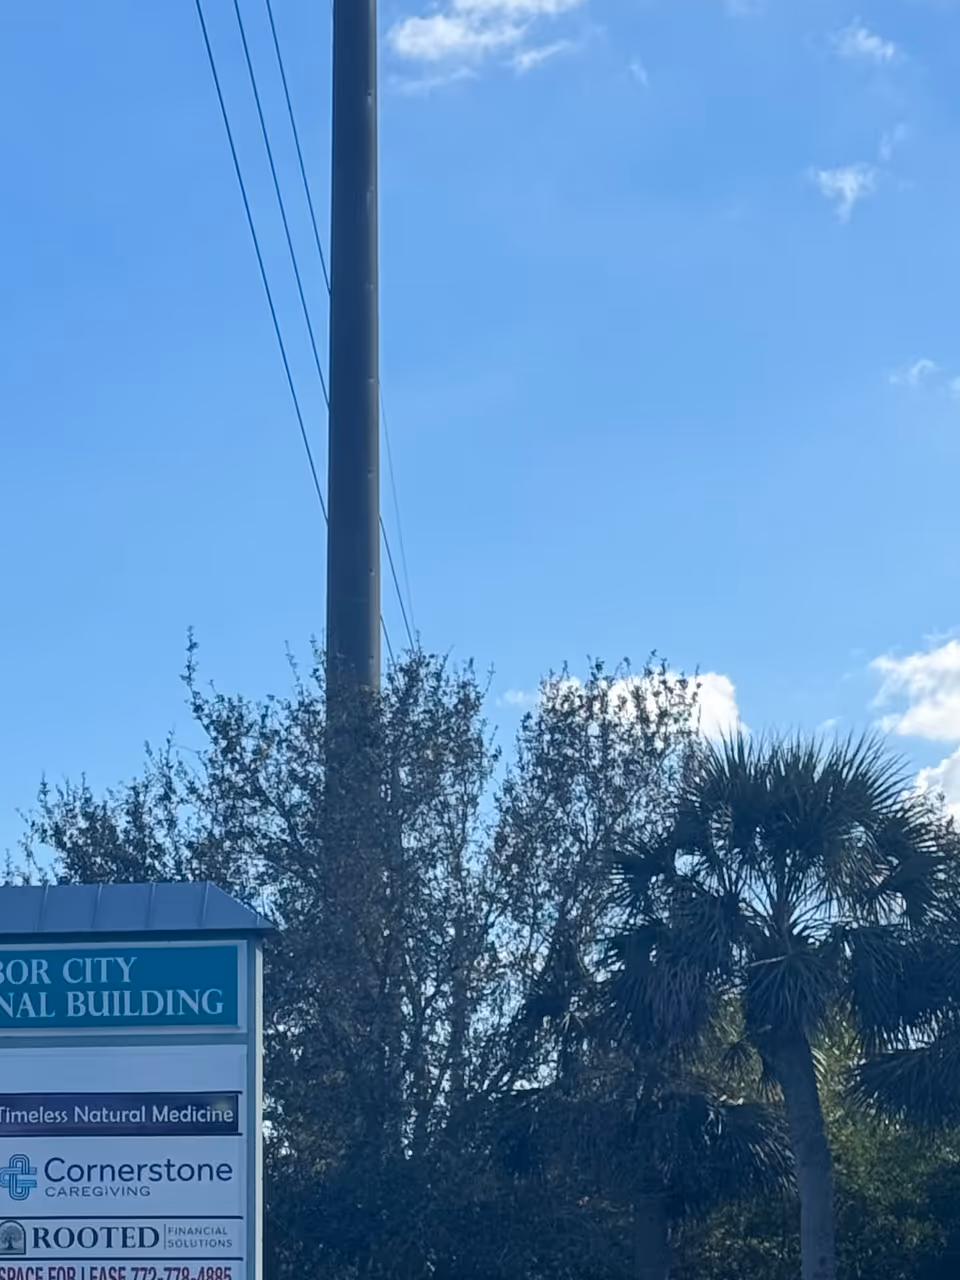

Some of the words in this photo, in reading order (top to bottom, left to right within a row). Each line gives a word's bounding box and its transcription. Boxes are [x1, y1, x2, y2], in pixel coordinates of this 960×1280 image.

[62, 956, 138, 984] CITY
[66, 988, 225, 1018] BUILDING
[74, 1105, 146, 1124] Natural
[151, 1104, 234, 1123] Medicine
[44, 1156, 233, 1183] Cornerstone
[45, 1186, 151, 1198] CAREGIVING
[31, 1226, 160, 1250] ROOTED
[168, 1225, 228, 1236] FINANCIAL
[168, 1238, 233, 1249] SOLUTIONS
